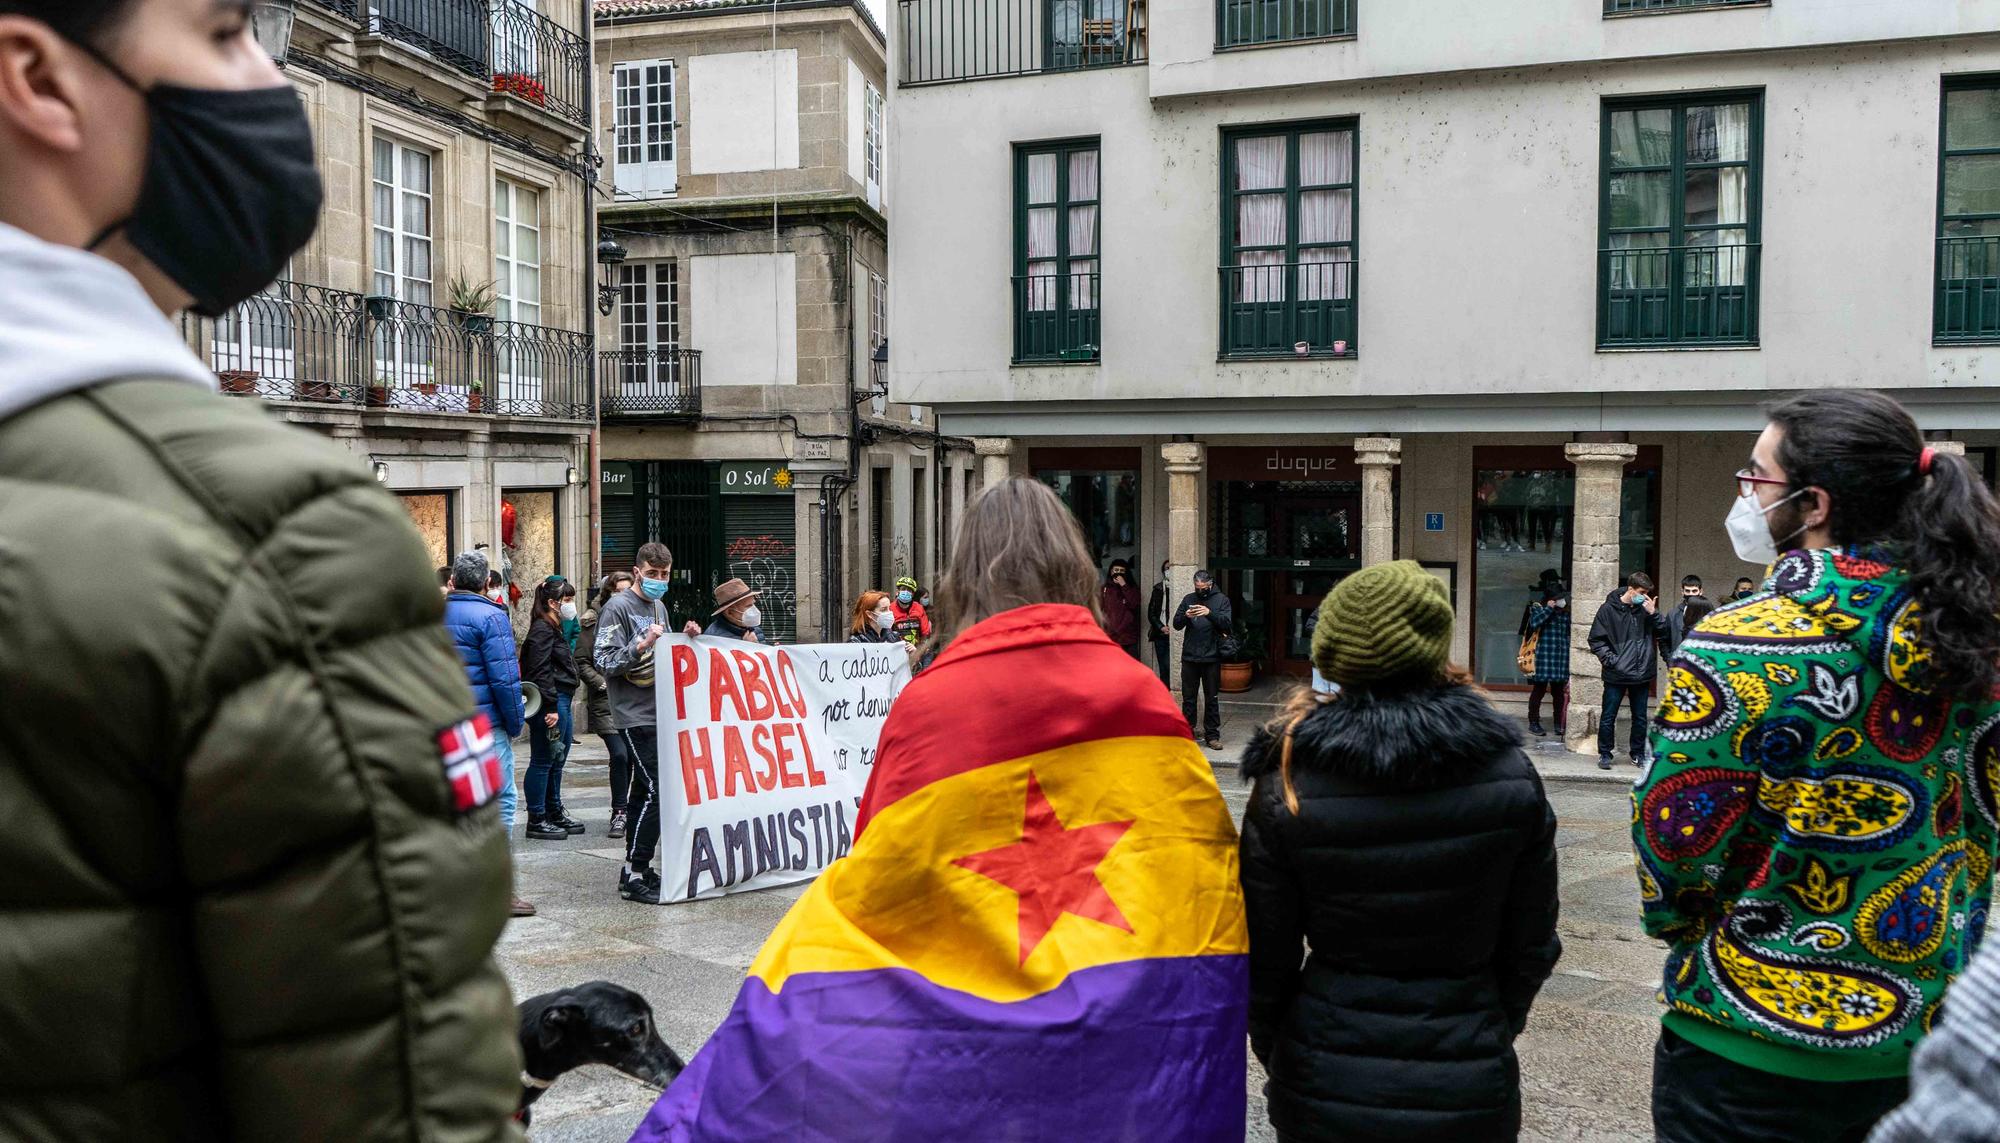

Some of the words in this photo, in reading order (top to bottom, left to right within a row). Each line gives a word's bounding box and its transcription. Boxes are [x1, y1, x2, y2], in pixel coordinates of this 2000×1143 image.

[602, 471, 626, 483] Bar
[726, 470, 738, 486] O
[743, 467, 771, 486] Sol
[1267, 449, 1336, 477] duque
[1431, 514, 1438, 524] R
[841, 647, 895, 680] cadeia
[671, 644, 808, 722] PABLO
[822, 699, 850, 735] por
[677, 722, 827, 806] HASEL
[686, 800, 852, 899] AMNISTIA
